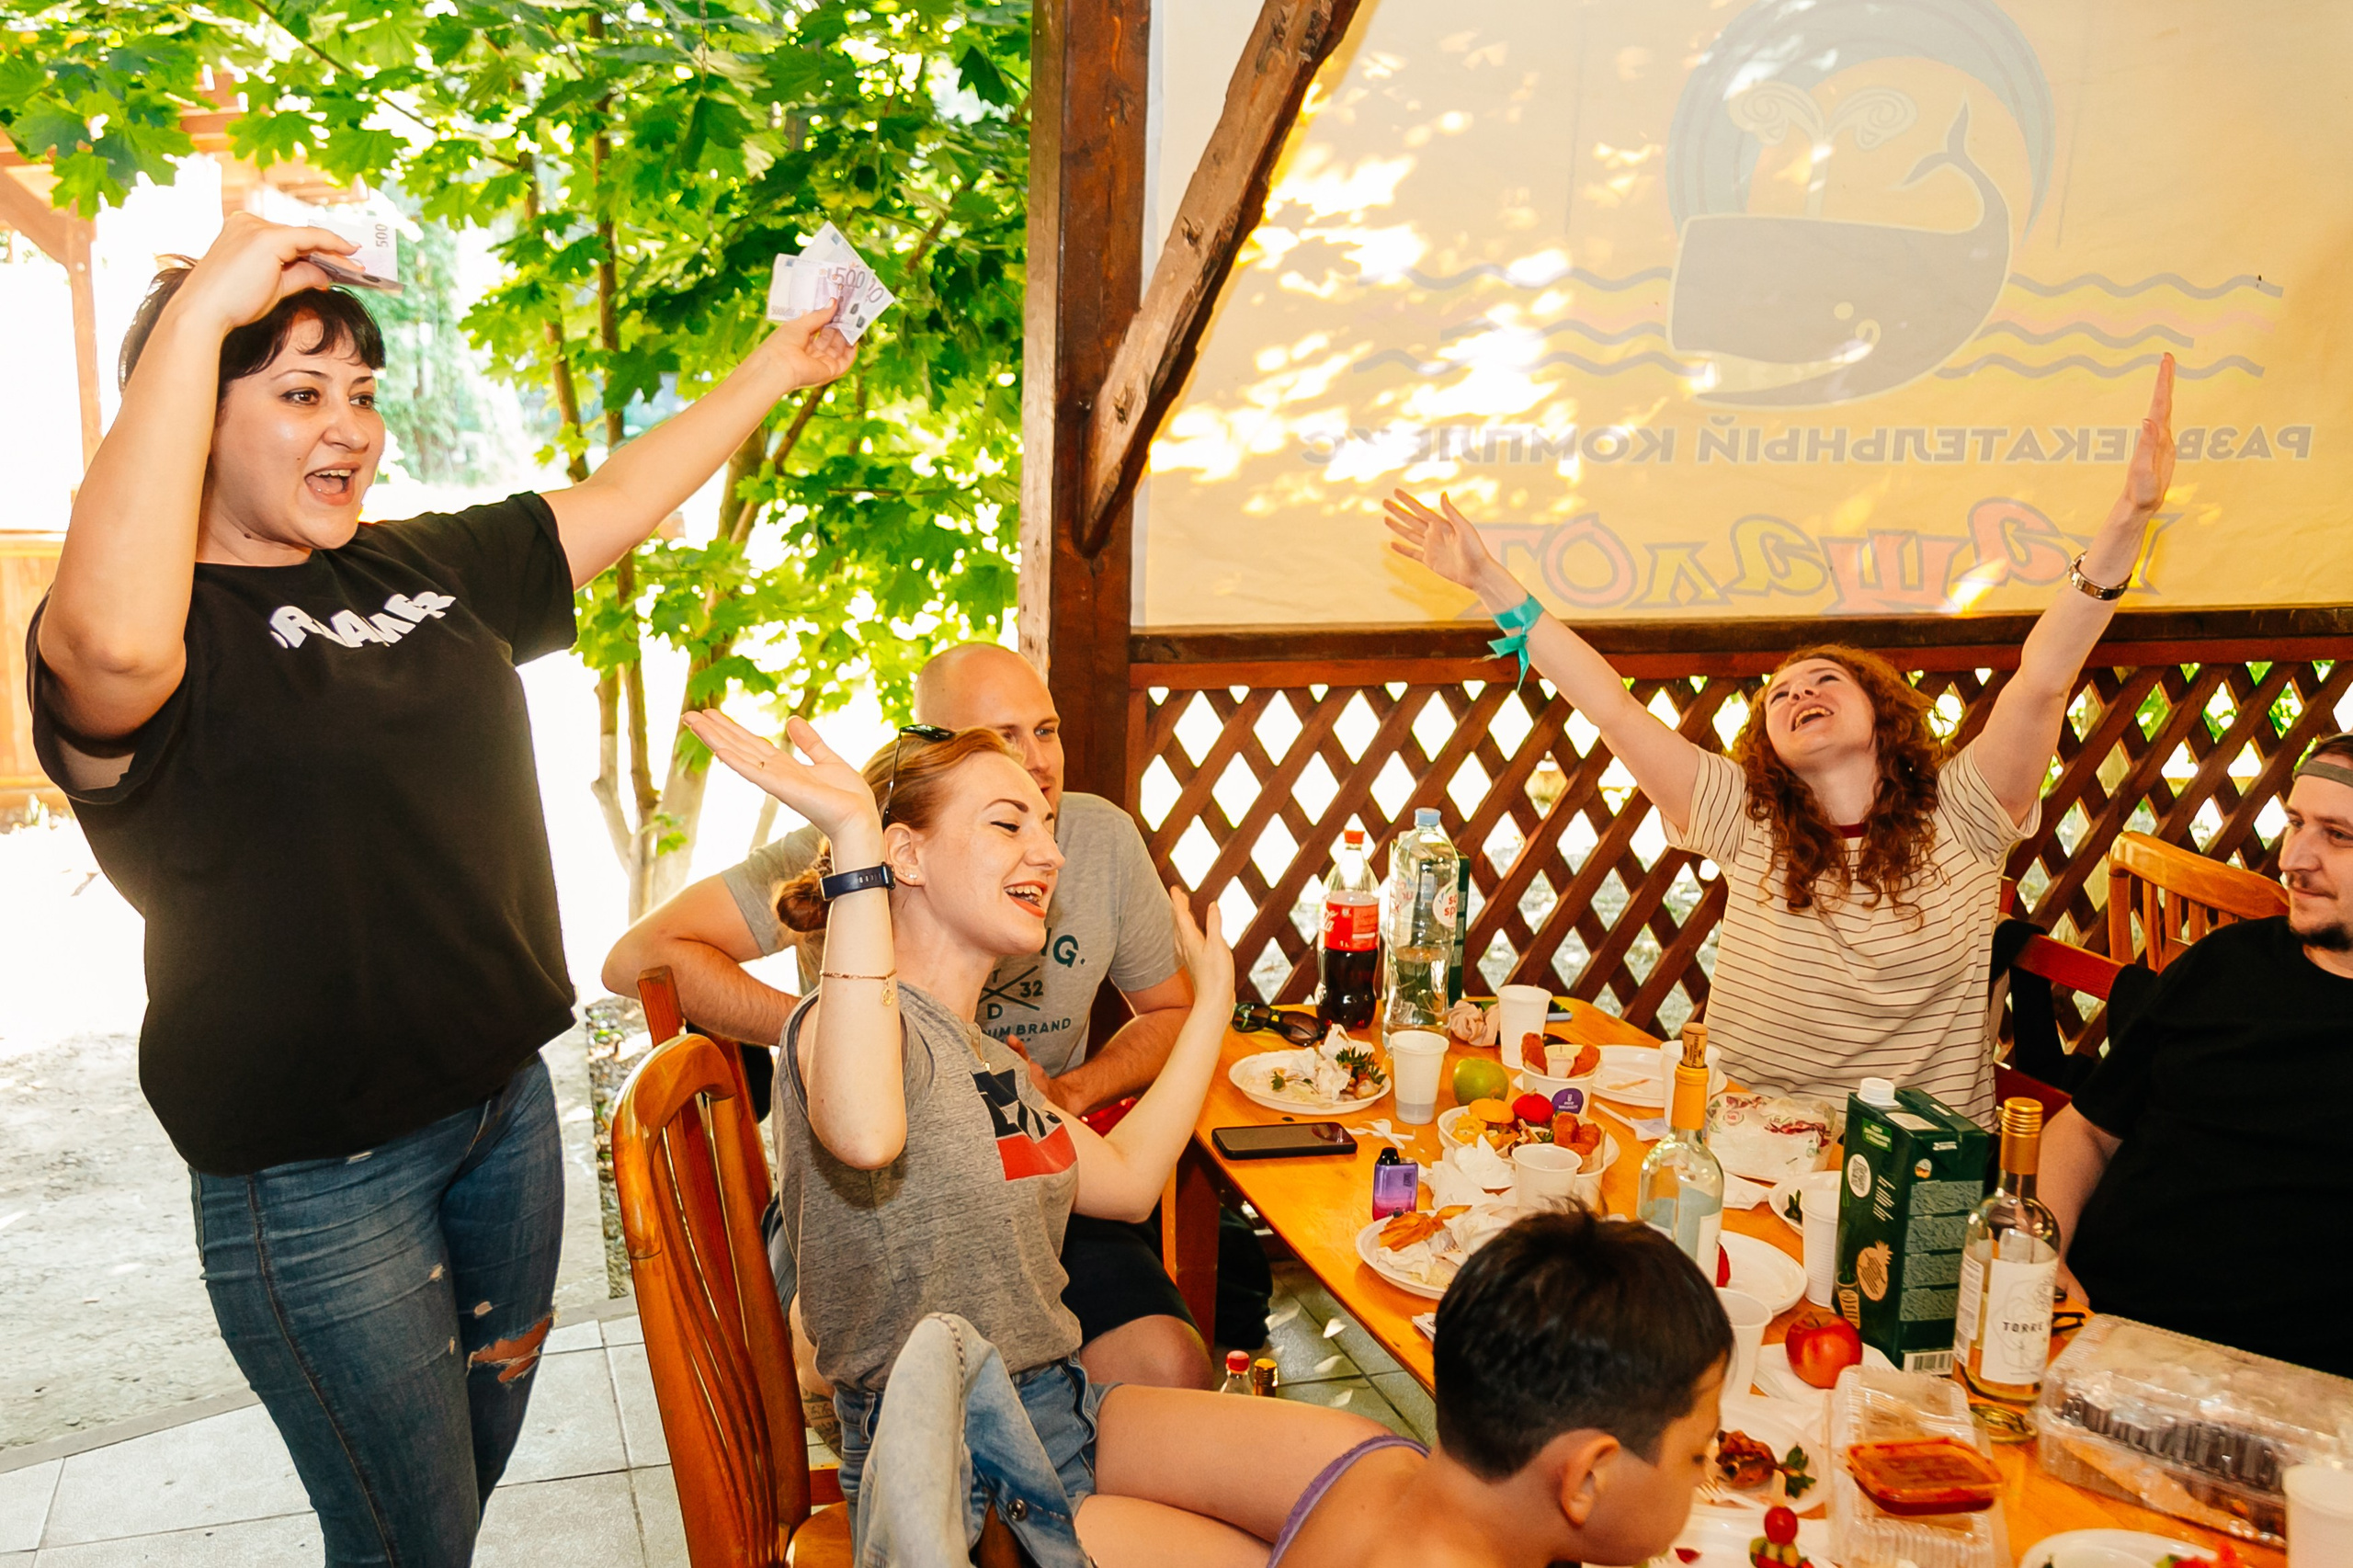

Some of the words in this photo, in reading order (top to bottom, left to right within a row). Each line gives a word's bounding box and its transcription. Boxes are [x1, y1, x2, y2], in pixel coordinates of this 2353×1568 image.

[835, 267, 866, 289] 500
[1019, 980, 1044, 998] 32
[986, 1003, 1004, 1019] D
[1016, 1017, 1072, 1036] BRAND
